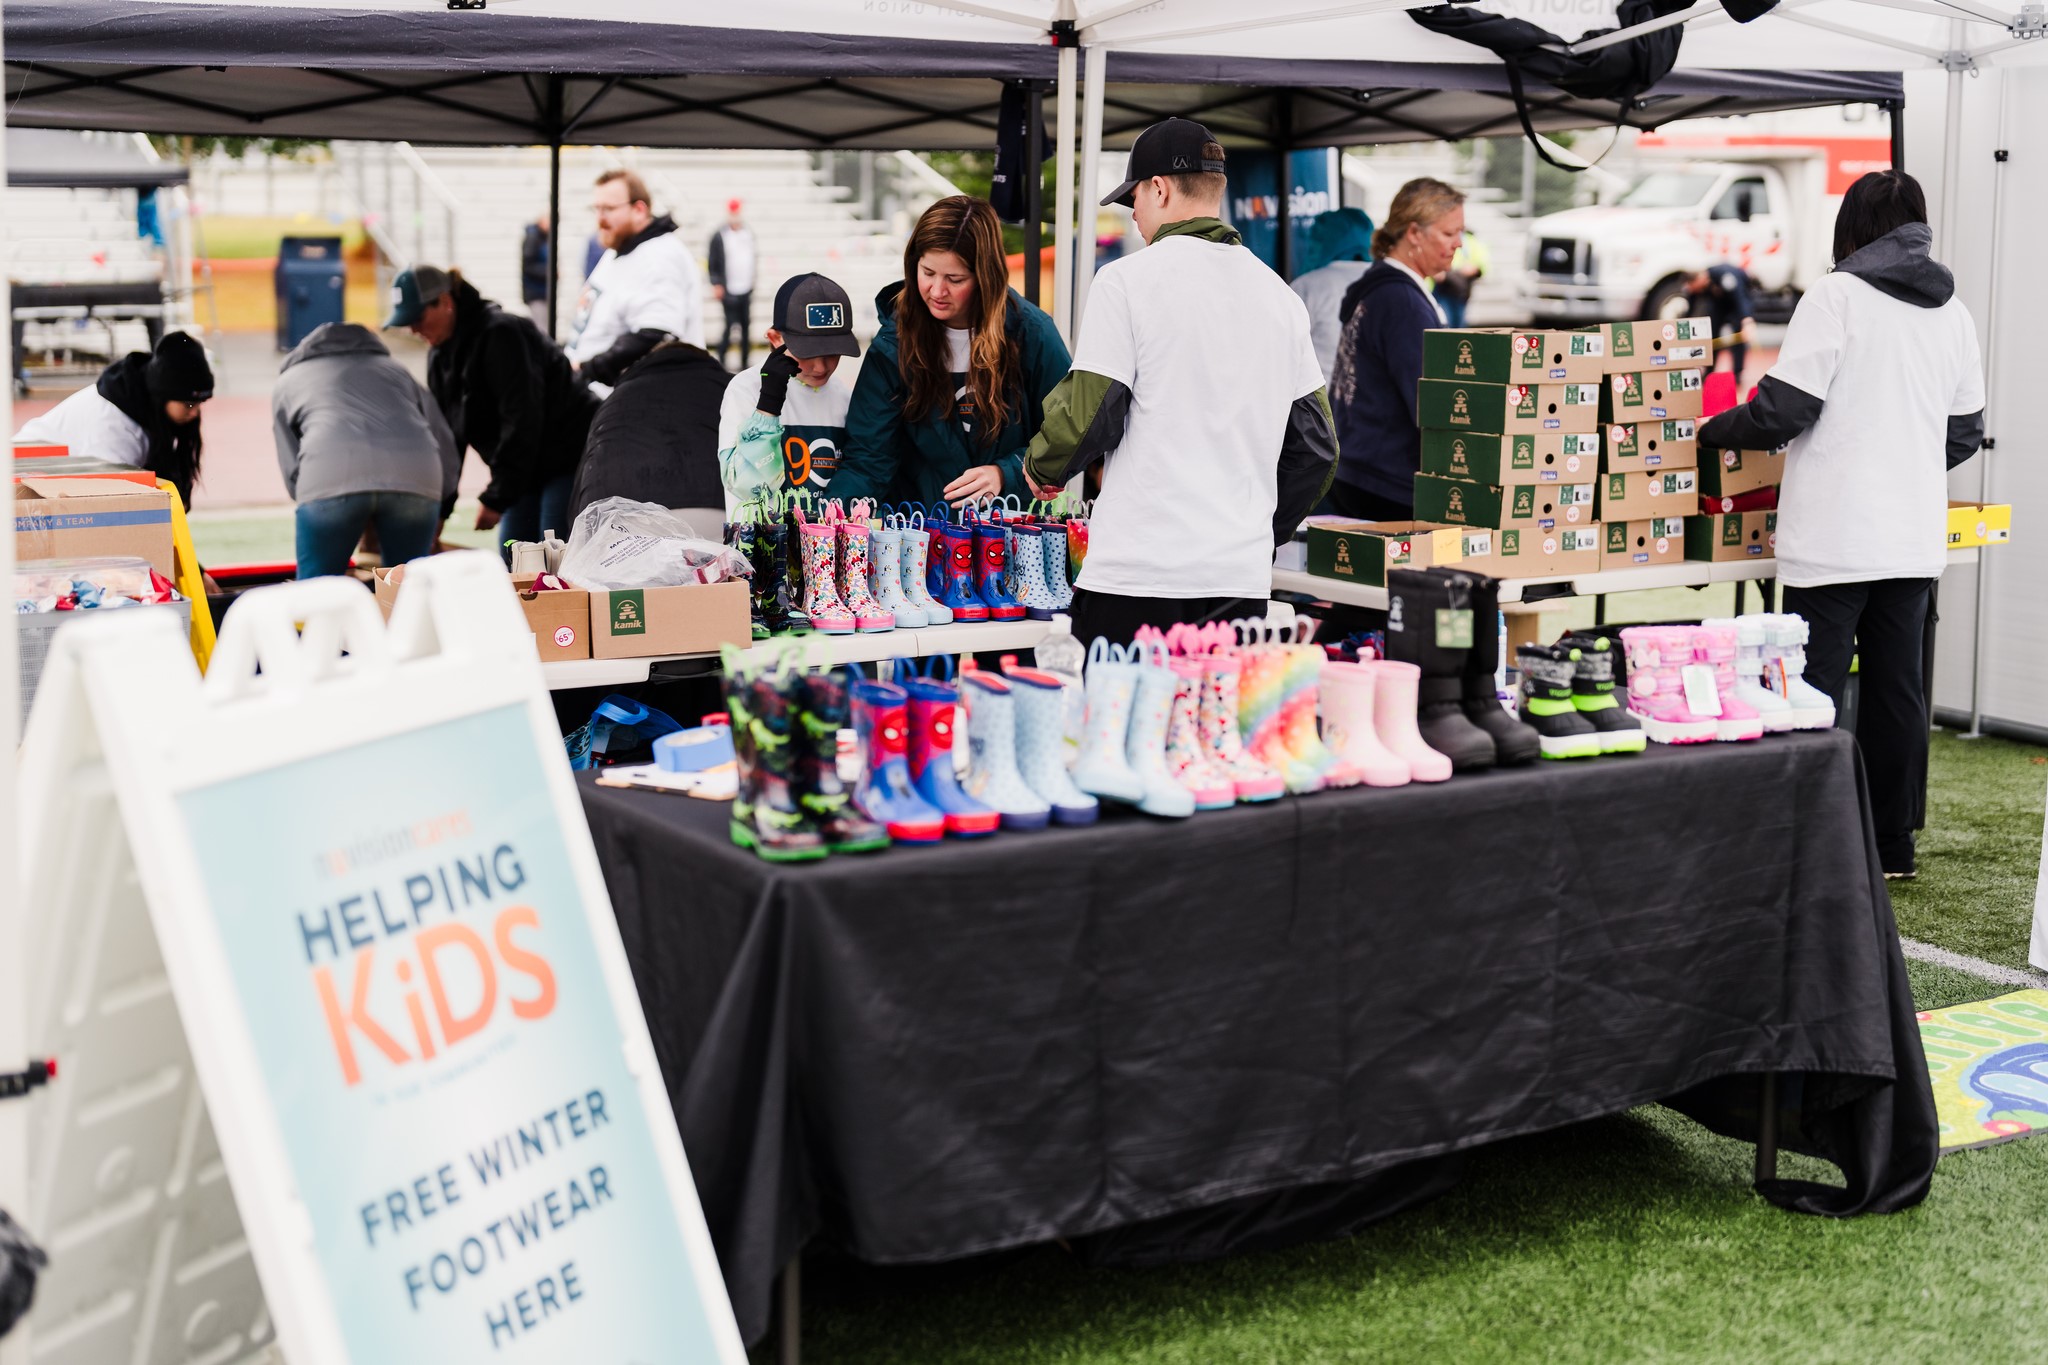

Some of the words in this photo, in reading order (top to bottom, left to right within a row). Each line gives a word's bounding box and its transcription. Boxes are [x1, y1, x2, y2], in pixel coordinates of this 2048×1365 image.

[1454, 365, 1476, 376] kamik
[1449, 414, 1471, 425] kamik
[1450, 463, 1470, 475] kamik
[14, 518, 52, 528] OMPANY
[56, 518, 62, 526] &
[66, 516, 94, 525] TEAM
[1445, 510, 1467, 522] kamik
[1334, 563, 1354, 576] kamik
[614, 620, 643, 629] kamik
[296, 842, 528, 963] HELPING
[360, 1162, 462, 1248] FREE
[467, 1088, 610, 1187] WINTER
[403, 1164, 614, 1312] FOOTWEAR
[484, 1260, 583, 1351] HERE
